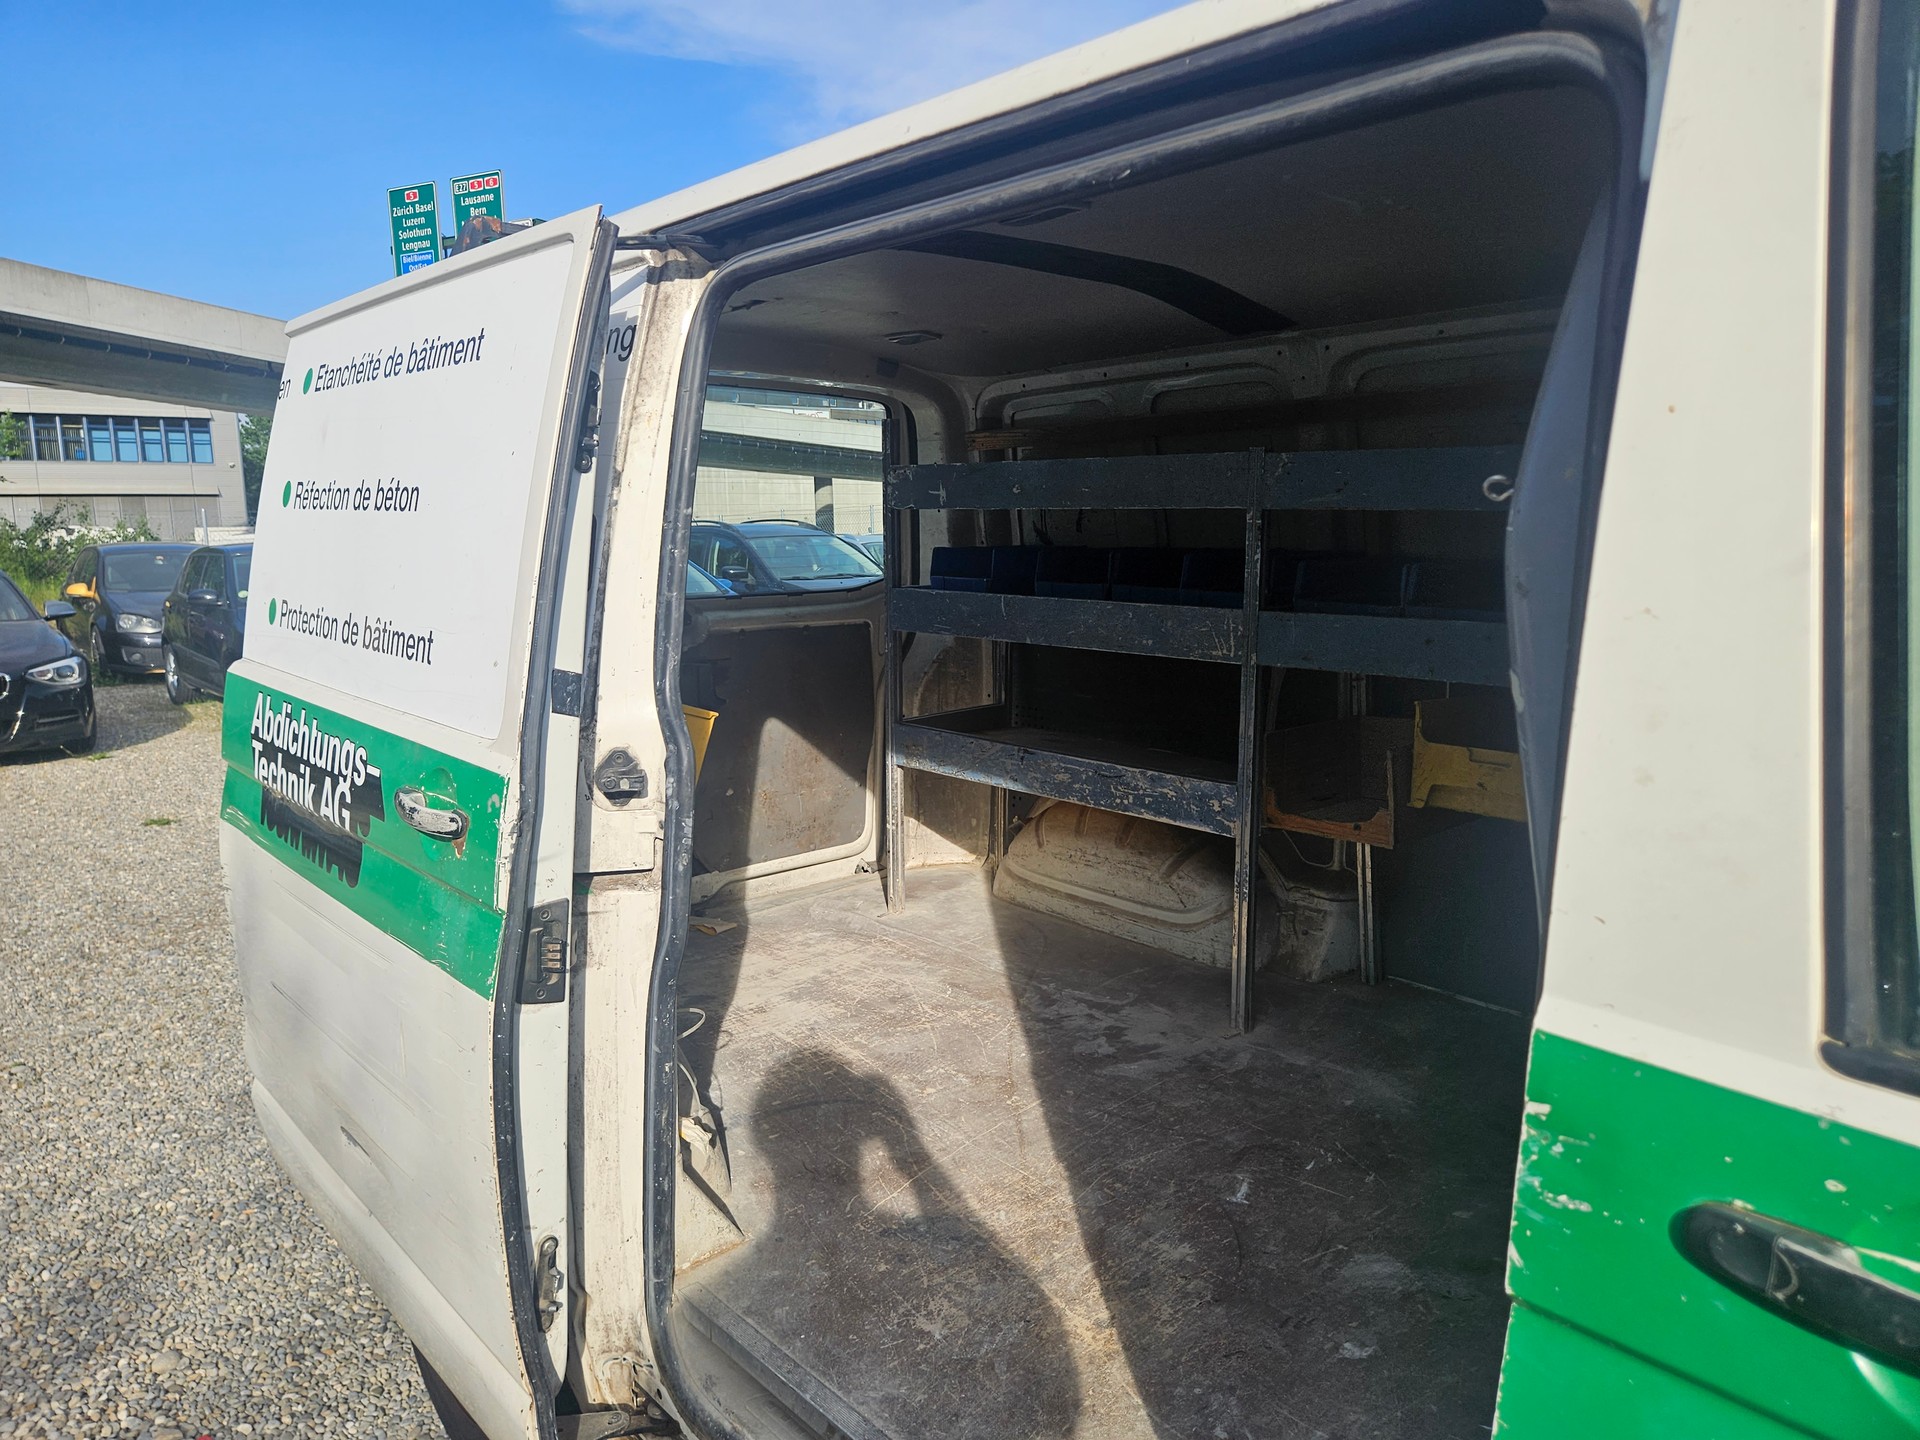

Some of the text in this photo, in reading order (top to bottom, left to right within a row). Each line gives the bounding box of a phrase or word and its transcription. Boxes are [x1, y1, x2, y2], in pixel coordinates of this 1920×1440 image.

[455, 182, 468, 194] E27
[460, 193, 494, 206] Lausanne
[392, 201, 434, 217] Zürich Basel
[470, 207, 487, 216] Bern
[402, 216, 425, 227] Luzern
[398, 227, 432, 240] Solothurn
[401, 240, 431, 252] Lengnau
[402, 253, 432, 263] Biel/Bienne
[314, 327, 485, 393] Etanchéité de bâtiment
[293, 477, 420, 512] Réfection de béton
[279, 599, 434, 666] Protection de bâtiment
[250, 691, 381, 788] Abdichtungs-
[251, 738, 352, 833] Technik AG
